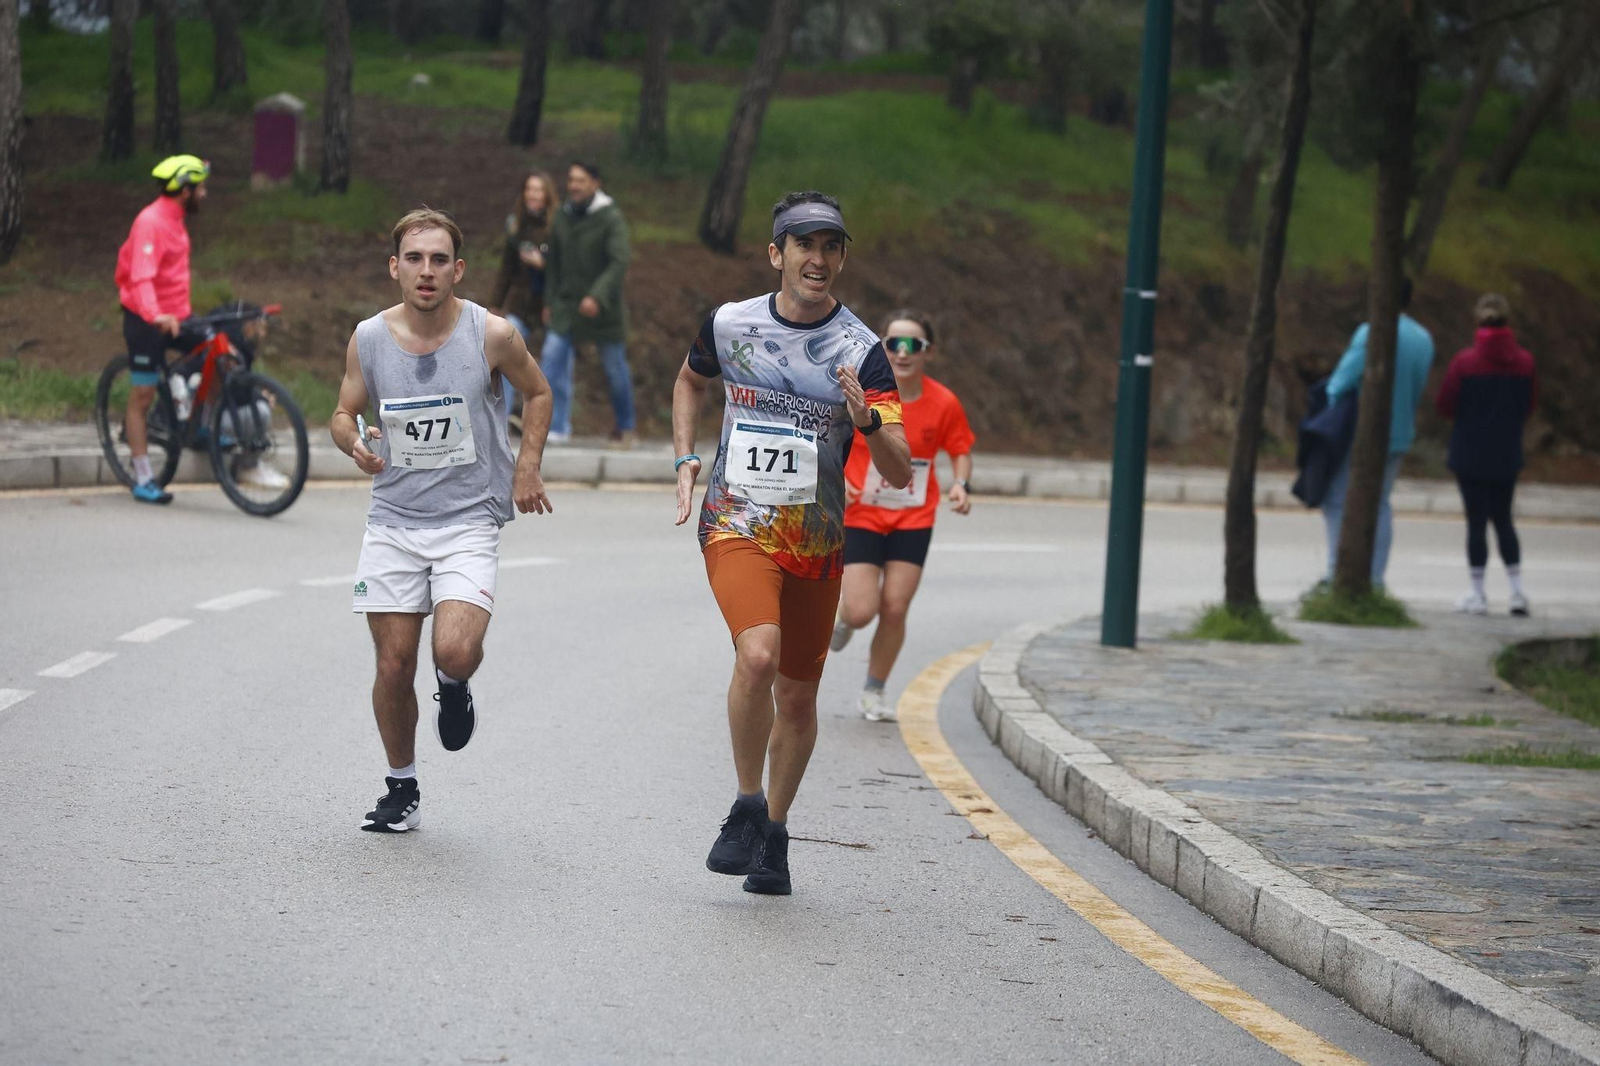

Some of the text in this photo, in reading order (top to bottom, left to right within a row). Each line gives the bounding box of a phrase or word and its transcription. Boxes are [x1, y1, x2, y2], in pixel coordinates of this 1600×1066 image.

[756, 393, 766, 401] LA
[766, 389, 833, 419] AFRICANA
[405, 417, 451, 442] 477
[747, 446, 798, 474] 171
